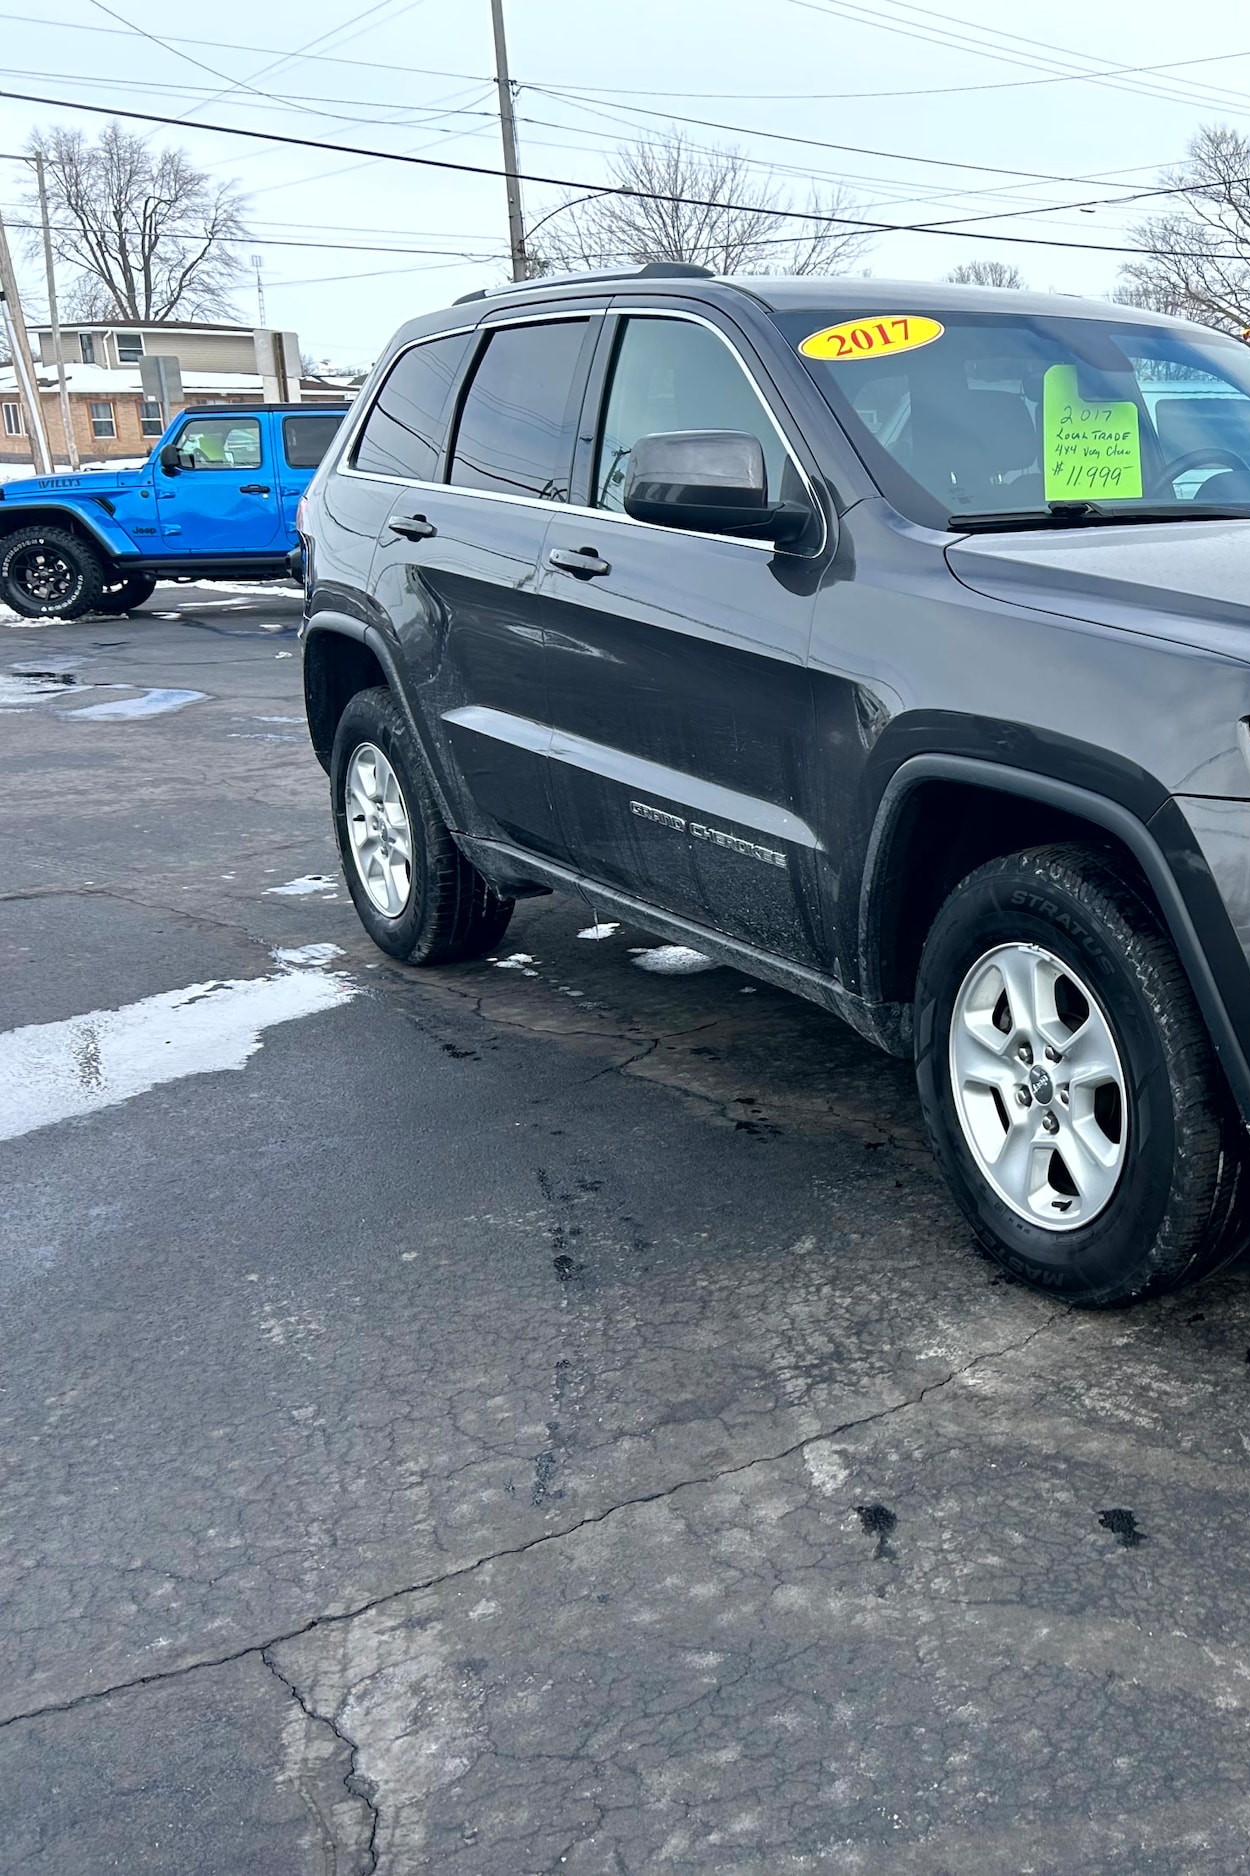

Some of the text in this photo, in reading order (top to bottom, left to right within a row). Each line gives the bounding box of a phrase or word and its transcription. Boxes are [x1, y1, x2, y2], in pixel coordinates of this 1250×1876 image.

[827, 319, 909, 356] 2017
[1091, 430, 1131, 440] TRADE
[38, 478, 81, 489] WILLYS
[629, 800, 788, 870] GRAND CHEROKEE
[1010, 889, 1116, 976] STRATUS
